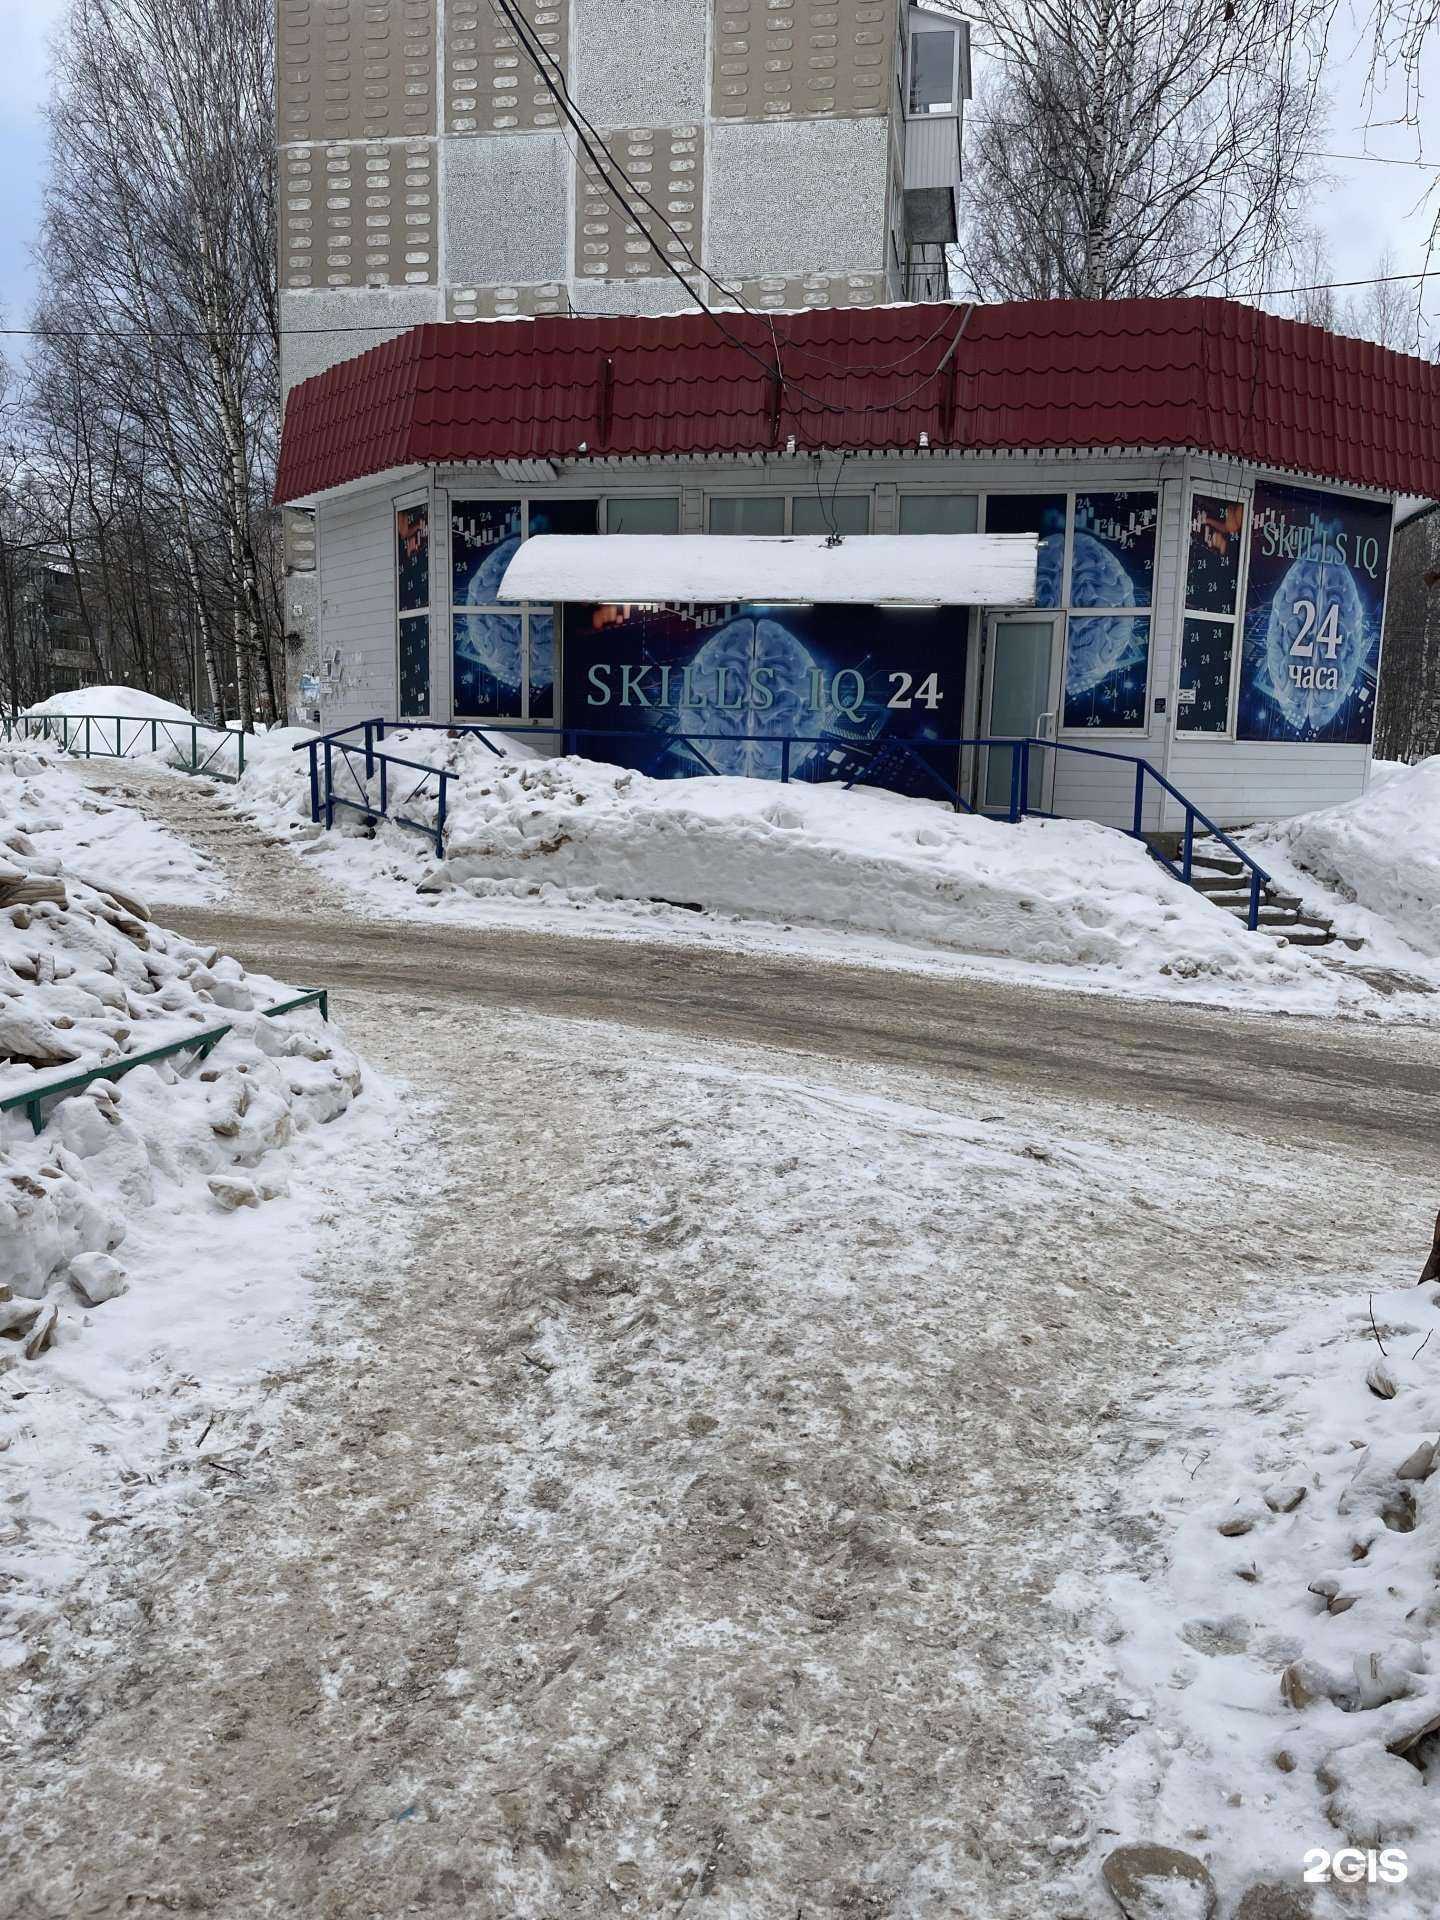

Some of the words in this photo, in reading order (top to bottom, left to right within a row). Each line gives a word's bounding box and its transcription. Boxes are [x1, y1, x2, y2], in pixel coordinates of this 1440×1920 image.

[1114, 491, 1129, 502] 24
[1077, 497, 1090, 509] 24
[1262, 521, 1348, 565] SKILLS
[1355, 535, 1379, 578] IQ
[455, 561, 468, 573] 24
[1198, 559, 1207, 569] 24
[1220, 556, 1229, 567] 24
[1208, 582, 1217, 592] 24
[1213, 629, 1222, 639] 24
[1289, 600, 1342, 659] 24
[1190, 632, 1200, 642] 24
[1201, 654, 1210, 664] 24
[1214, 676, 1223, 686] 24
[1289, 665, 1339, 690] часа
[478, 694, 490, 704] 24
[587, 664, 776, 710] SKILLS
[808, 666, 866, 723] IQ
[887, 672, 943, 709] 24
[1104, 688, 1119, 699] 24
[1203, 701, 1212, 711] 24
[1123, 708, 1139, 720] 24
[1087, 715, 1101, 727] 24
[1216, 721, 1225, 731] 24
